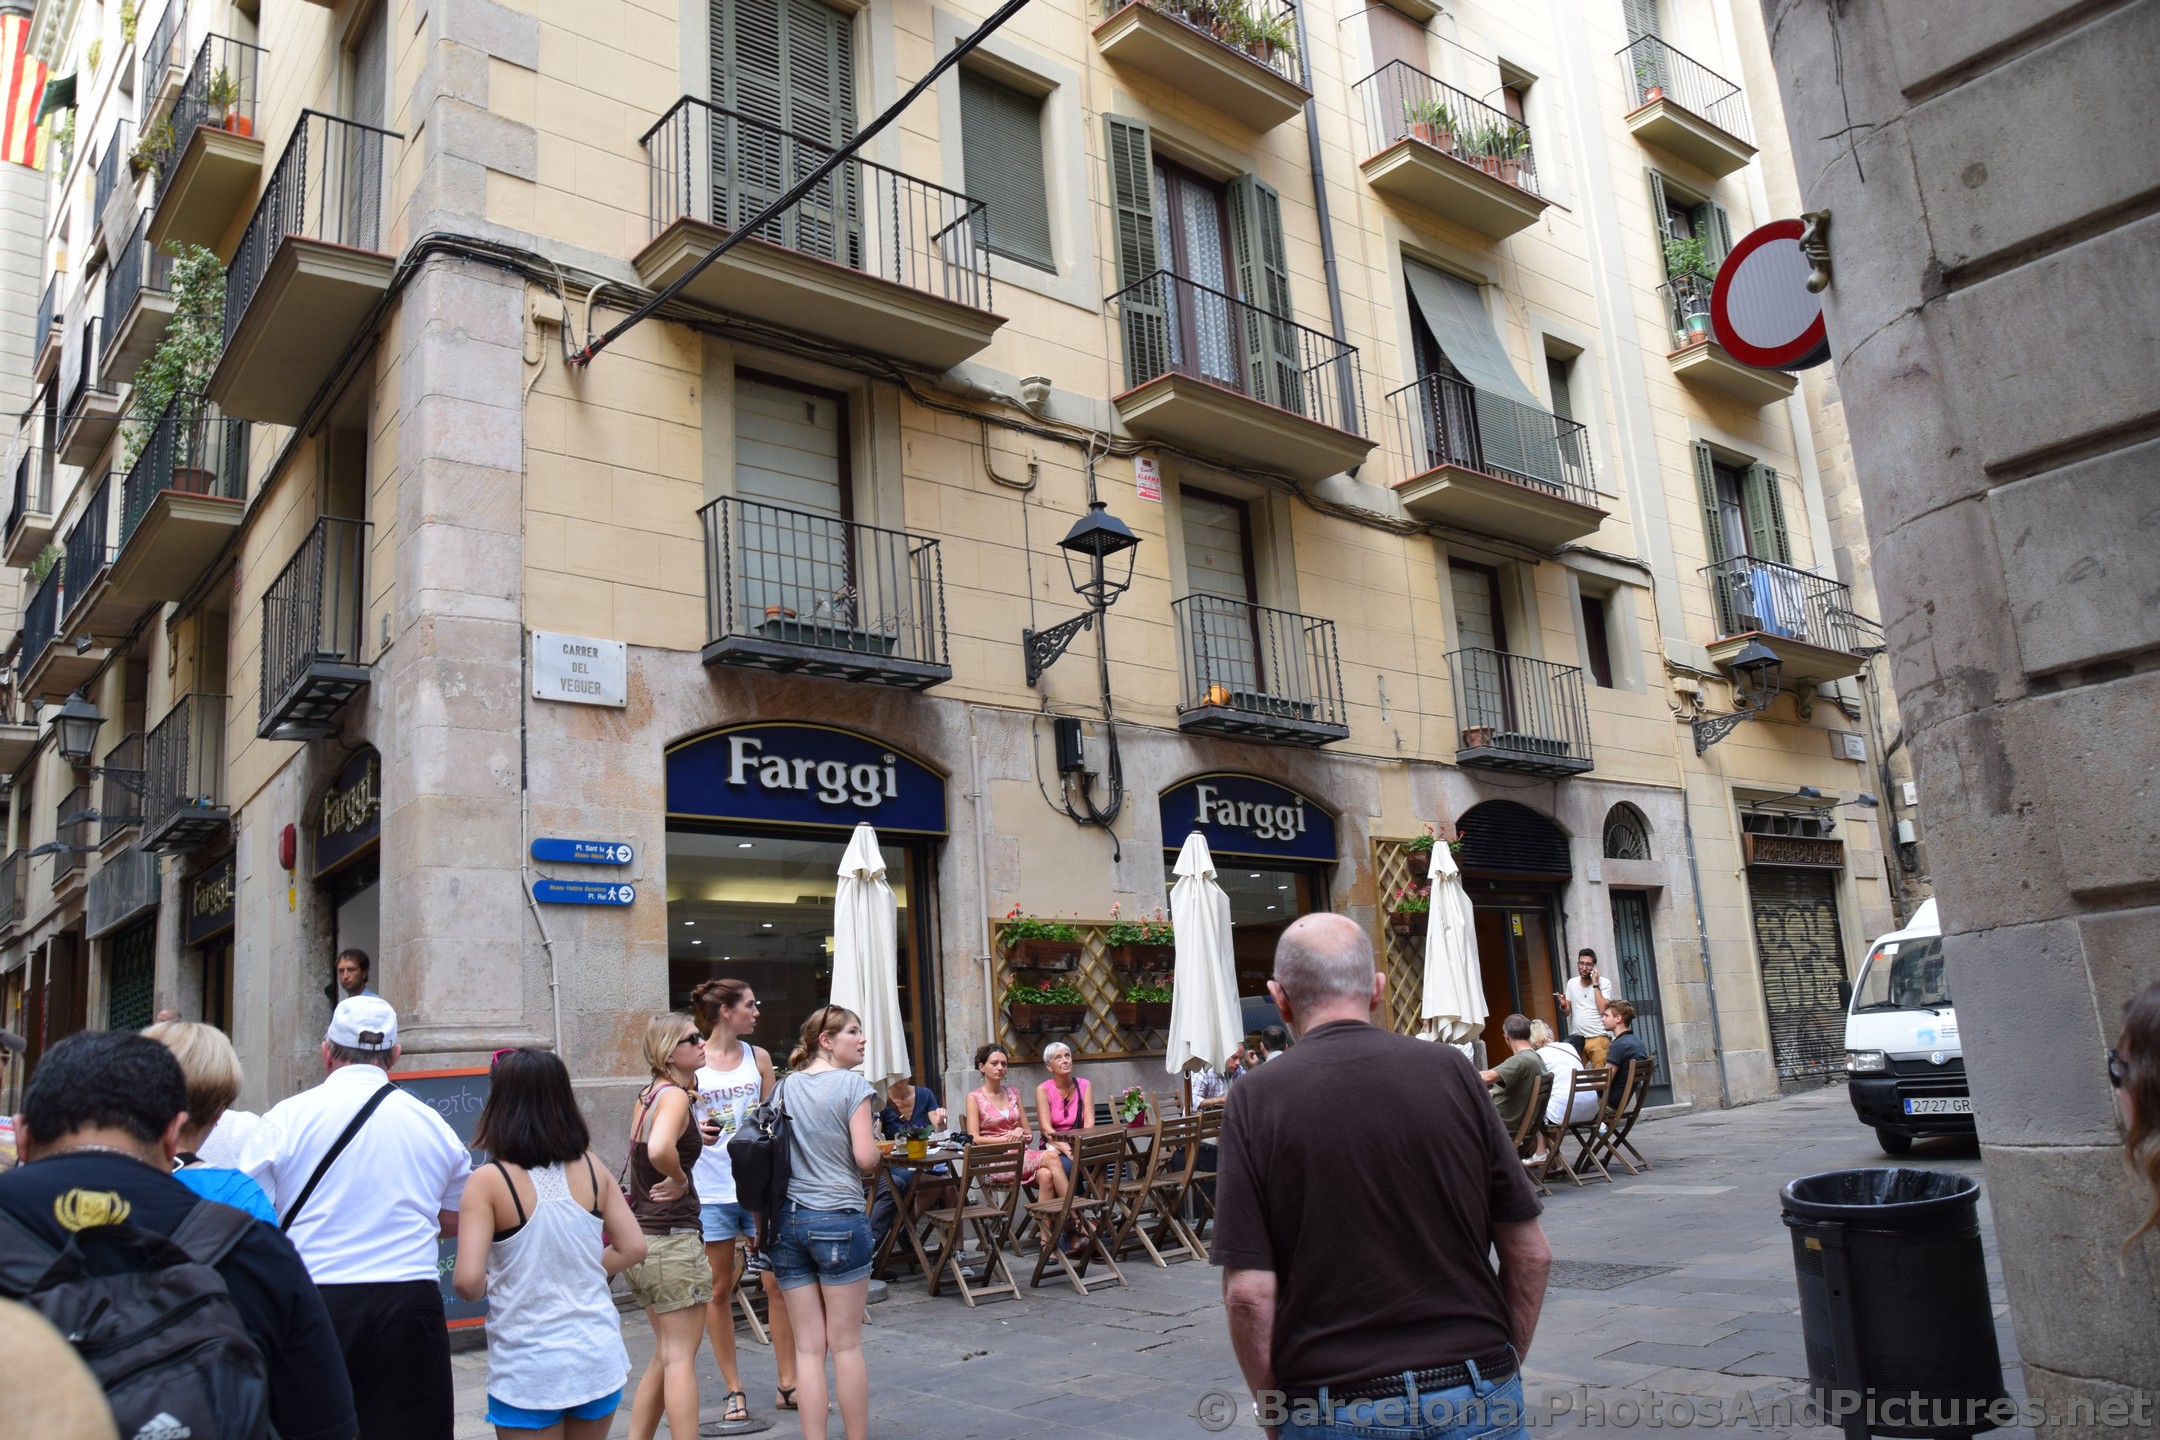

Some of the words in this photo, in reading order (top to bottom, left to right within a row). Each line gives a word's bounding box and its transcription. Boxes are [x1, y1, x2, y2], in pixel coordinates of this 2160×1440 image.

[1138, 473, 1159, 482] ALARMA
[562, 643, 599, 659] CARRER
[571, 661, 590, 675] DEL
[560, 677, 602, 696] VEGUER
[727, 735, 899, 808] Farggi
[1195, 783, 1307, 842] Farggi
[585, 844, 598, 852] Sant
[1913, 1099, 1947, 1113] 2727
